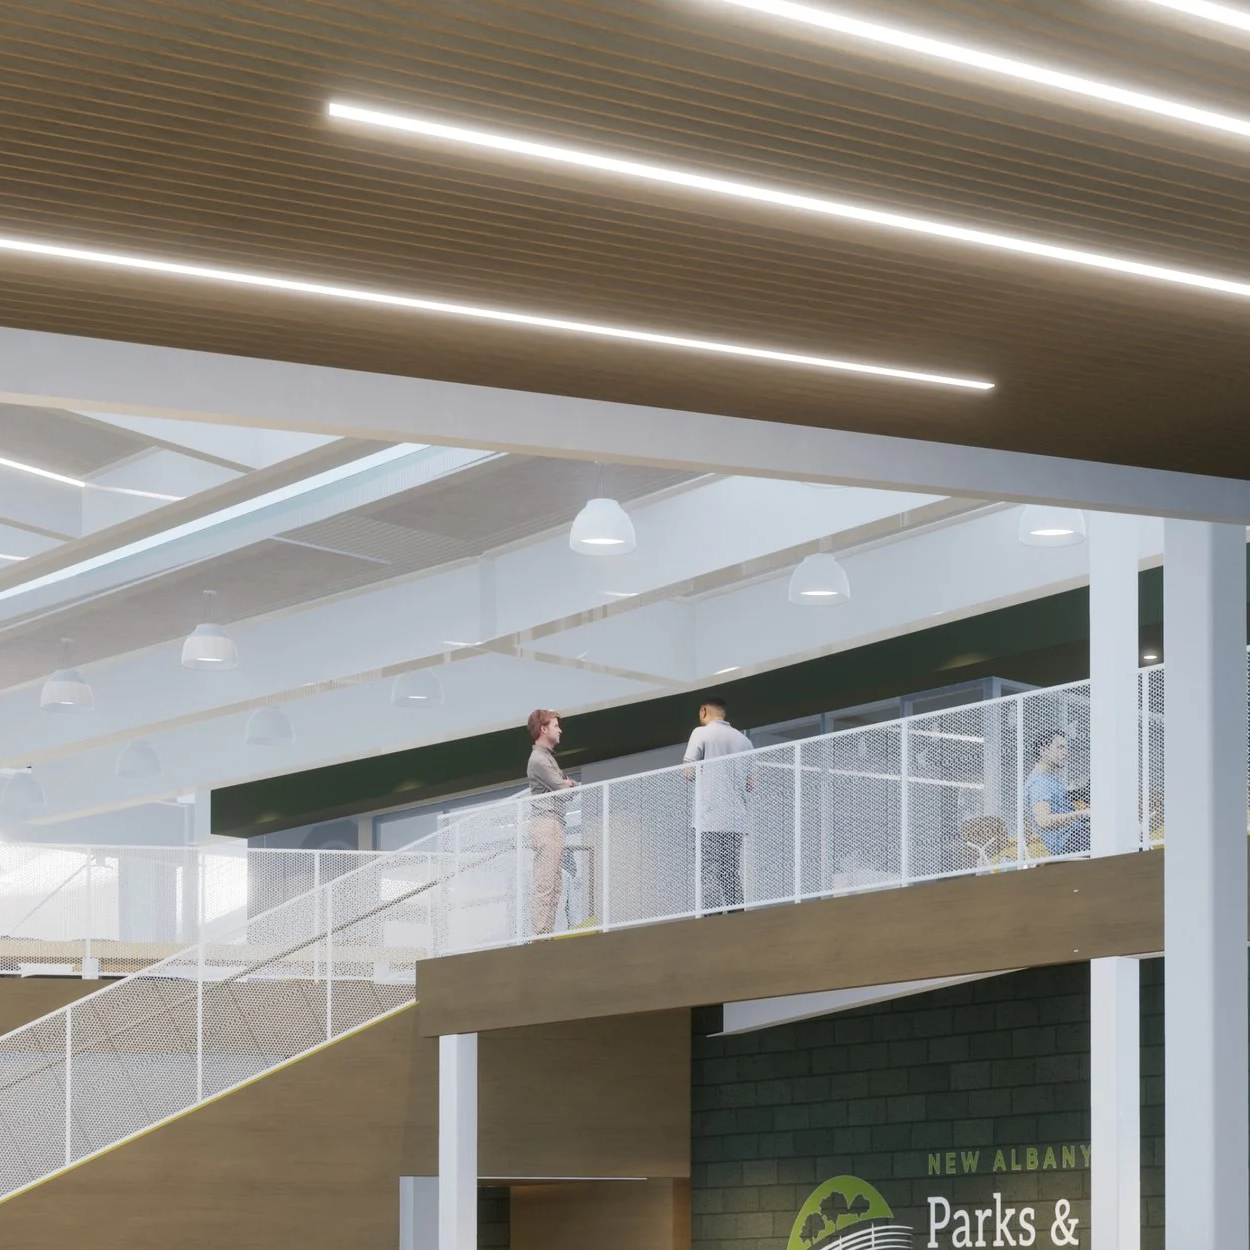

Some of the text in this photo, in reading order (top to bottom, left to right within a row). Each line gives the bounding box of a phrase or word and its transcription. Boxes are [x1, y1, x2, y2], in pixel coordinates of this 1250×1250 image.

[928, 1144, 1091, 1175] NEW ALBANY
[927, 1192, 1079, 1249] Parks &
